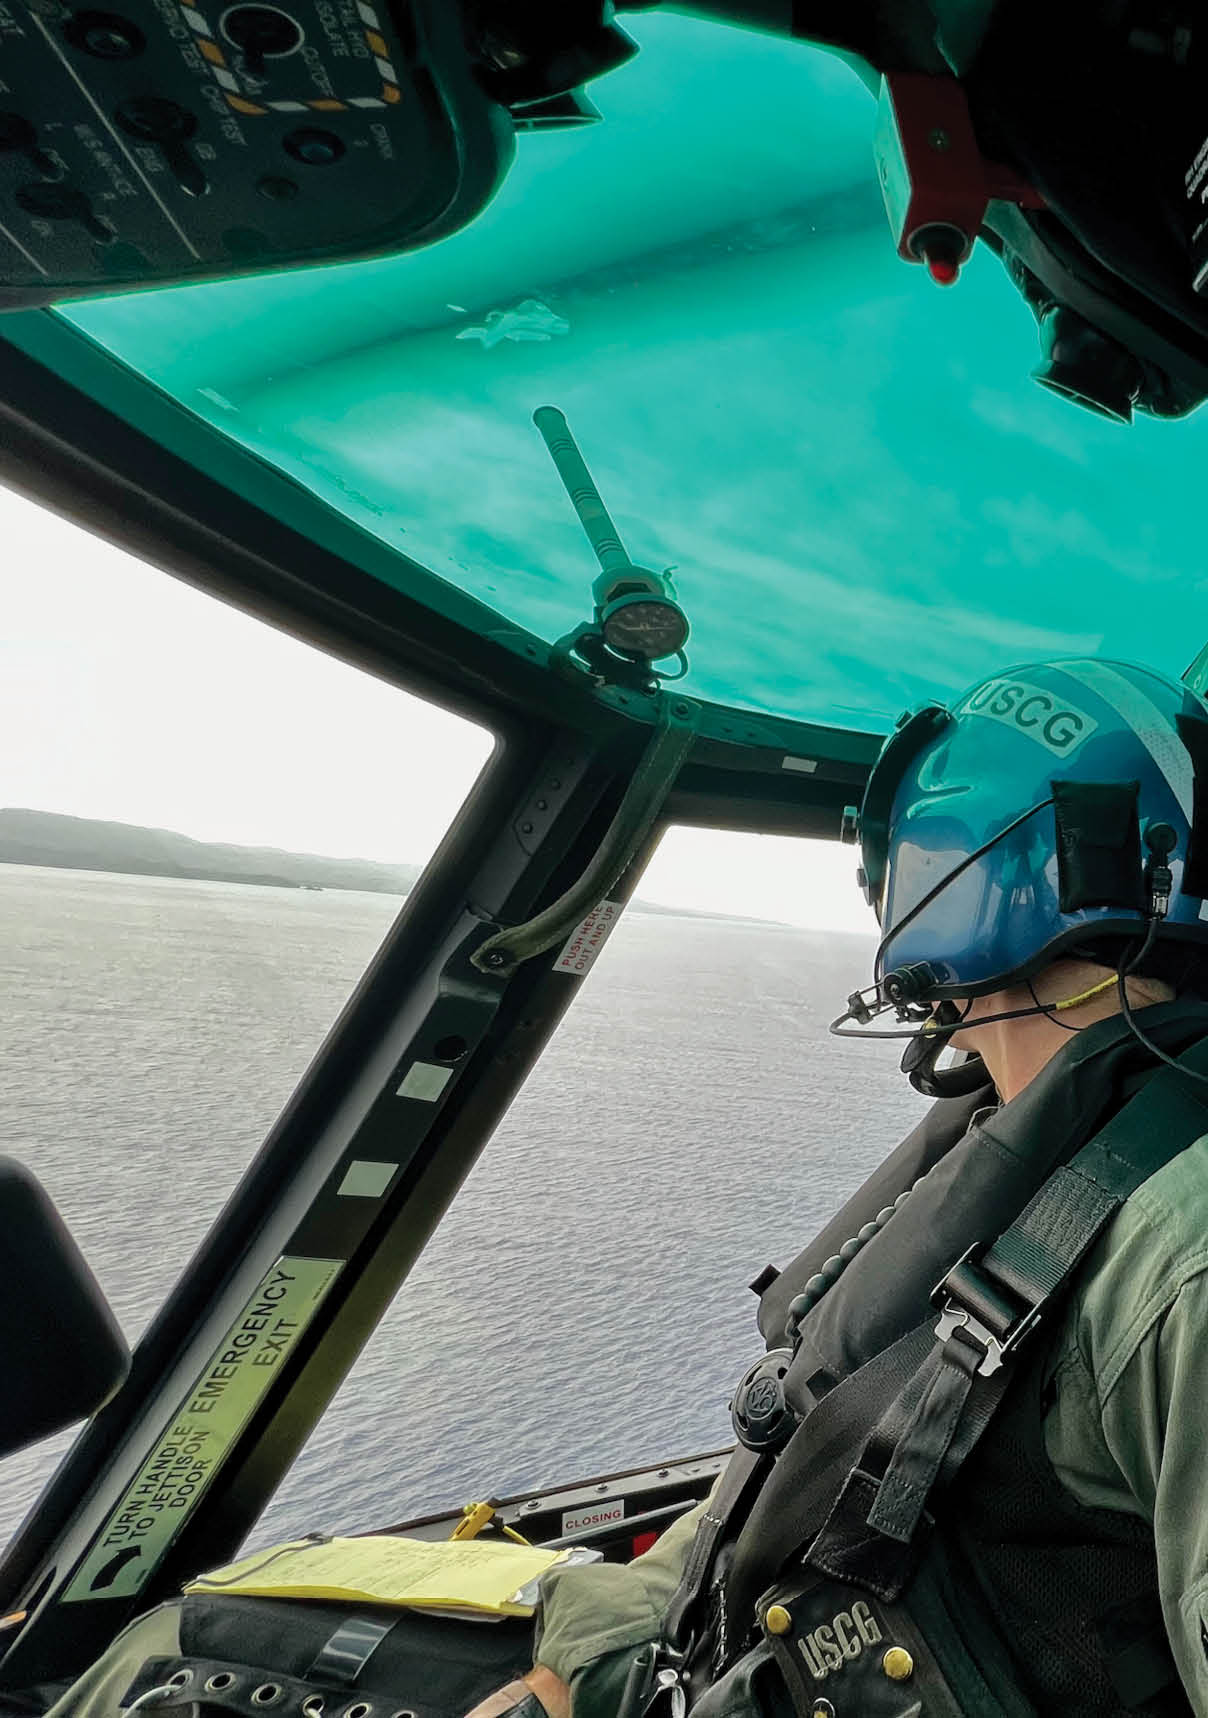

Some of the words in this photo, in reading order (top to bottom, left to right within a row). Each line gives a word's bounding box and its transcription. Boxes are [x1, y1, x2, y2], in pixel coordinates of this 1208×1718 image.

[968, 680, 1084, 749] USCG
[562, 935, 583, 966] PUSH
[581, 907, 603, 934] HERE
[575, 949, 592, 969] OUT
[589, 923, 606, 946] AND
[602, 906, 615, 921] UP
[190, 1270, 297, 1413] EMERGENCY
[252, 1319, 299, 1366] EXIT
[104, 1501, 144, 1548] TURN
[136, 1425, 192, 1496] HANDLE
[129, 1517, 154, 1541] TO
[154, 1430, 210, 1514] JETTISON
[169, 1458, 212, 1508] DOOR
[566, 1508, 622, 1529] CLOSING
[798, 1601, 883, 1679] USCG
